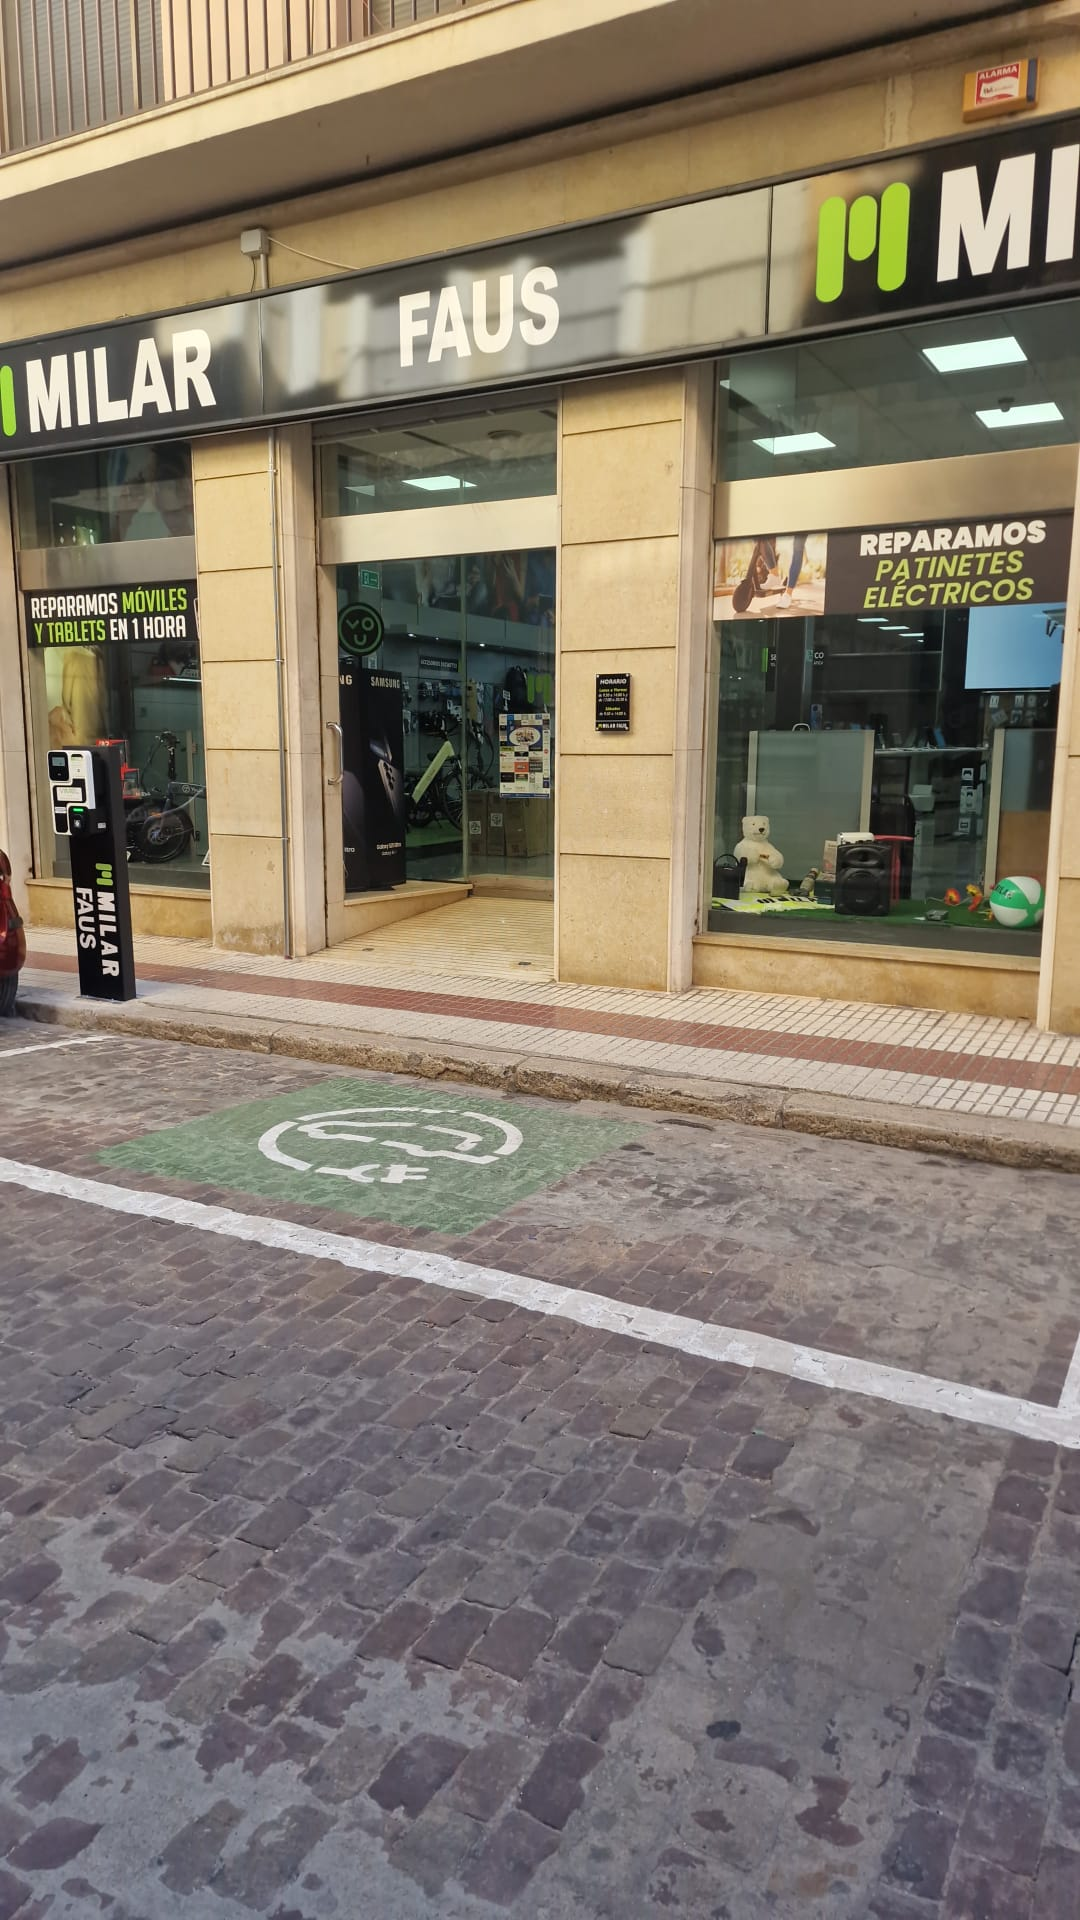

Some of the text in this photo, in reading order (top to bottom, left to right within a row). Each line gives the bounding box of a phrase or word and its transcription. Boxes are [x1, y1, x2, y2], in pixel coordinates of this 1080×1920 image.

[979, 65, 1018, 80] ALARMA
[936, 143, 1080, 283] MI
[399, 266, 560, 367] FAUS
[25, 328, 217, 433] MILAR
[859, 520, 1047, 557] REPARAMOS
[874, 550, 1025, 582] PATINETES
[31, 586, 188, 619] REPARAMOS MÓVILES
[863, 577, 1035, 609] ELÉCTRICOS
[34, 615, 187, 644] Y TABLETS EN 1 HORA
[370, 676, 400, 689] SAMSUNG
[76, 887, 97, 949] FAUS
[97, 891, 120, 977] MILAR
